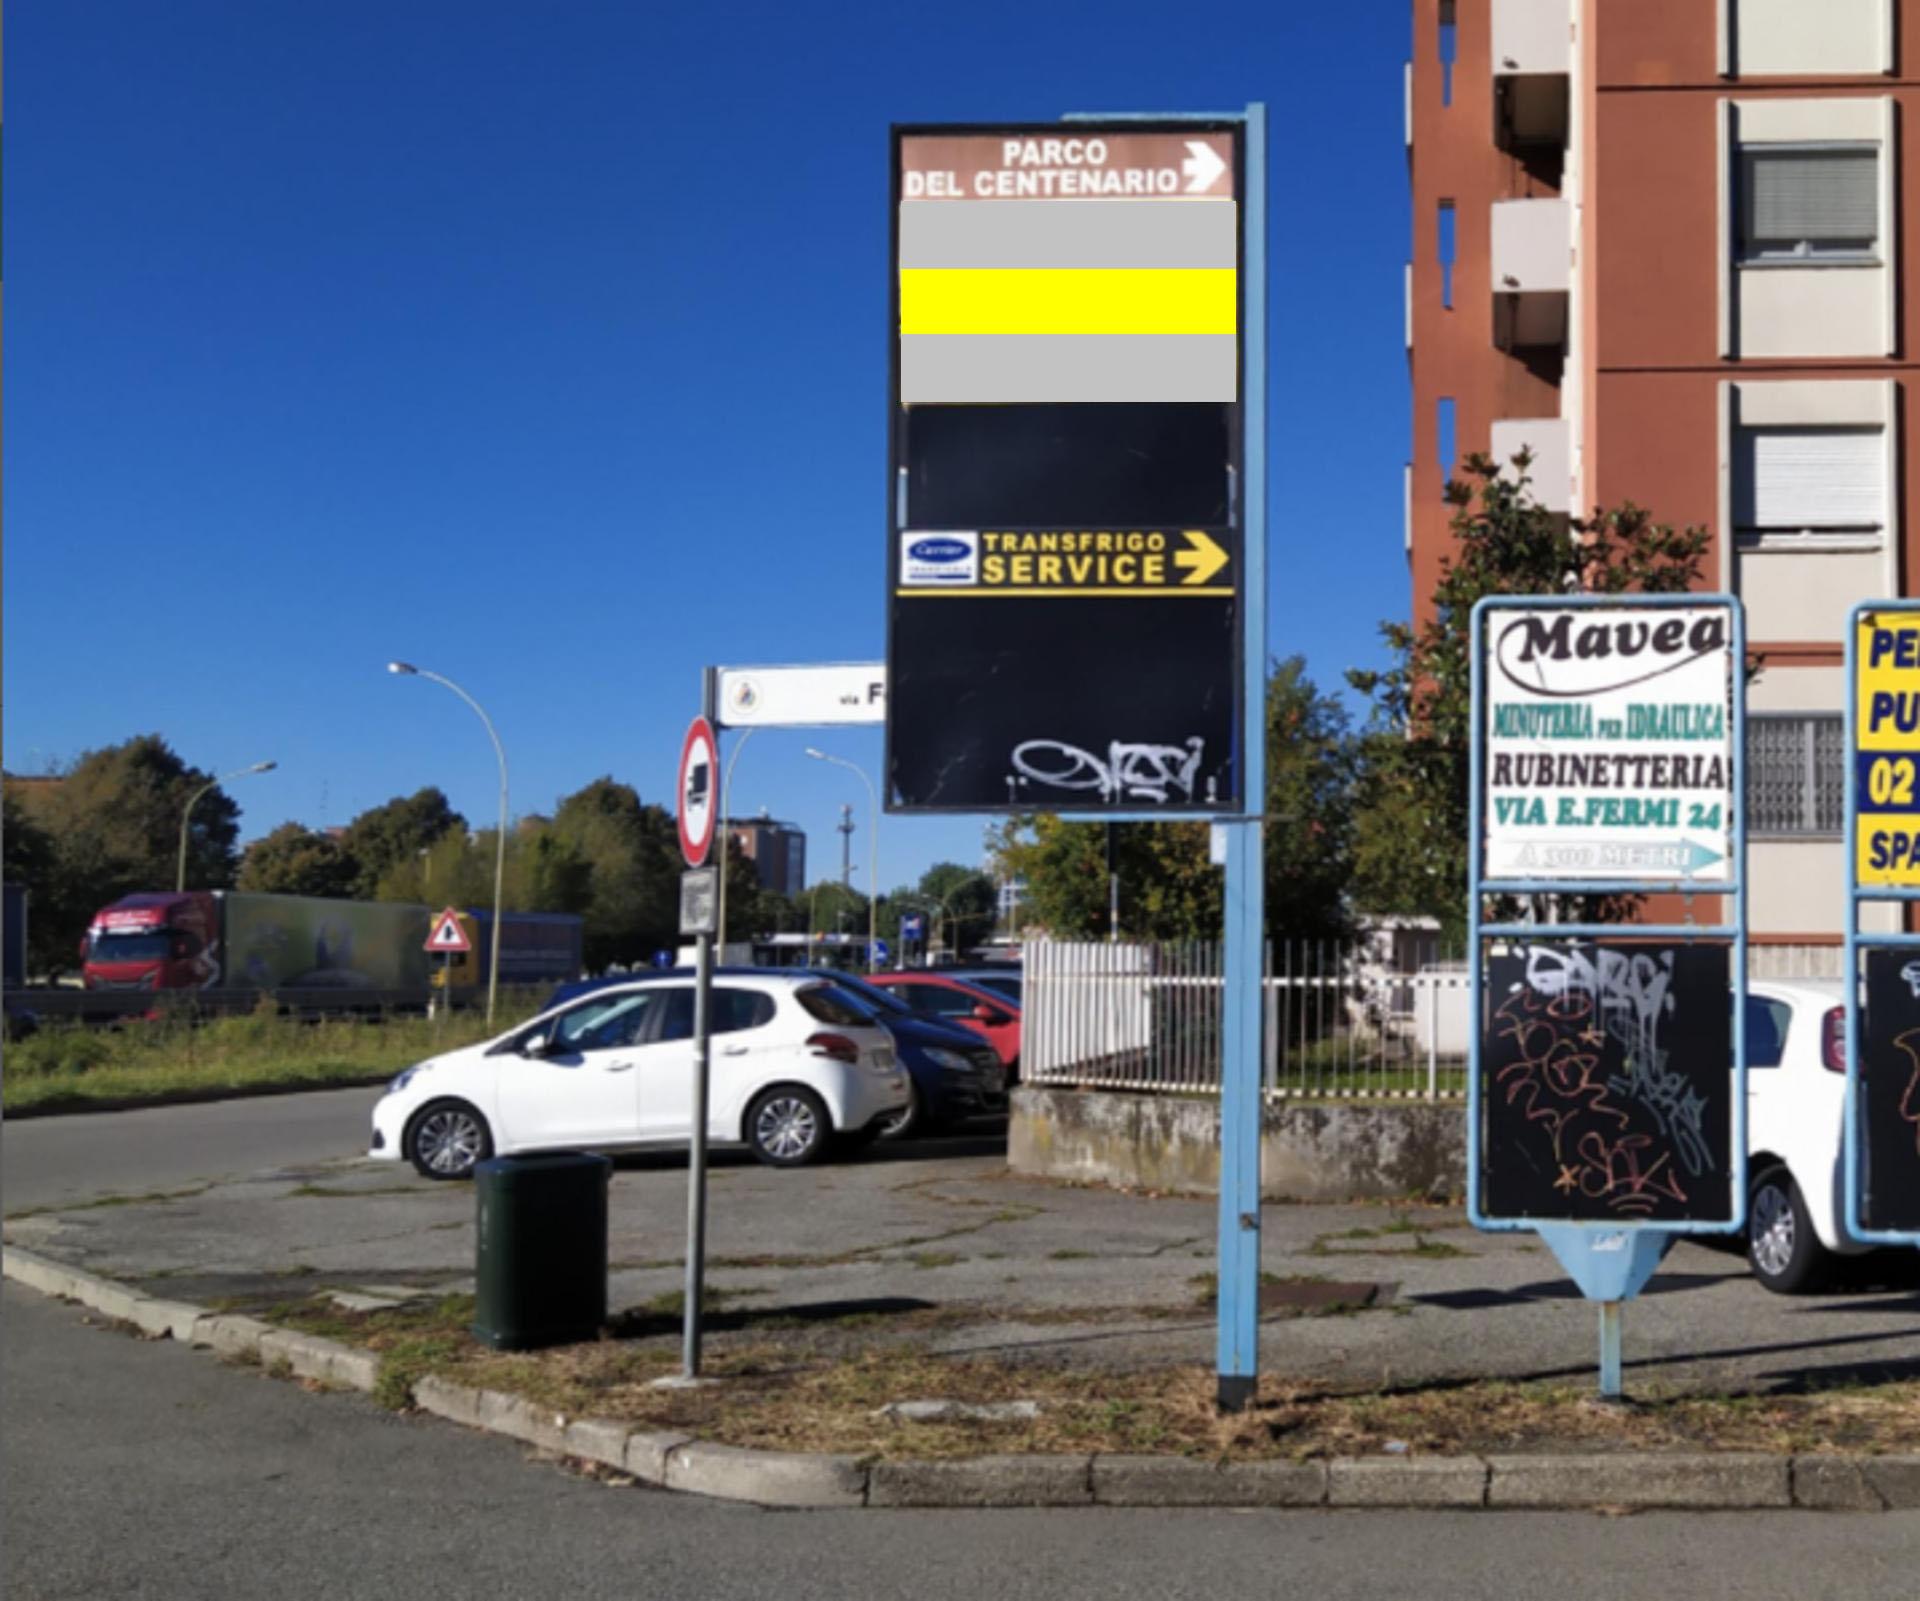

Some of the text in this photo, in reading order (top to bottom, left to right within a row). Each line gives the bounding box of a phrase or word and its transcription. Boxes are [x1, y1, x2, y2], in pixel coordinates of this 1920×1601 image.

[1003, 140, 1107, 167] PARCO
[905, 169, 1178, 197] DEL CENTENARIO
[982, 533, 1166, 552] TRANSFRIGO
[982, 555, 1166, 584] SERVICE
[1518, 614, 1725, 662] Mavea
[1870, 629, 1920, 669] PE
[1493, 703, 1724, 740] MINUTERIA PER IDRAULICA
[1493, 753, 1725, 788] RUBINETTERIA
[1869, 757, 1916, 805] 02
[1494, 796, 1722, 830] VIA E.FERMI 24
